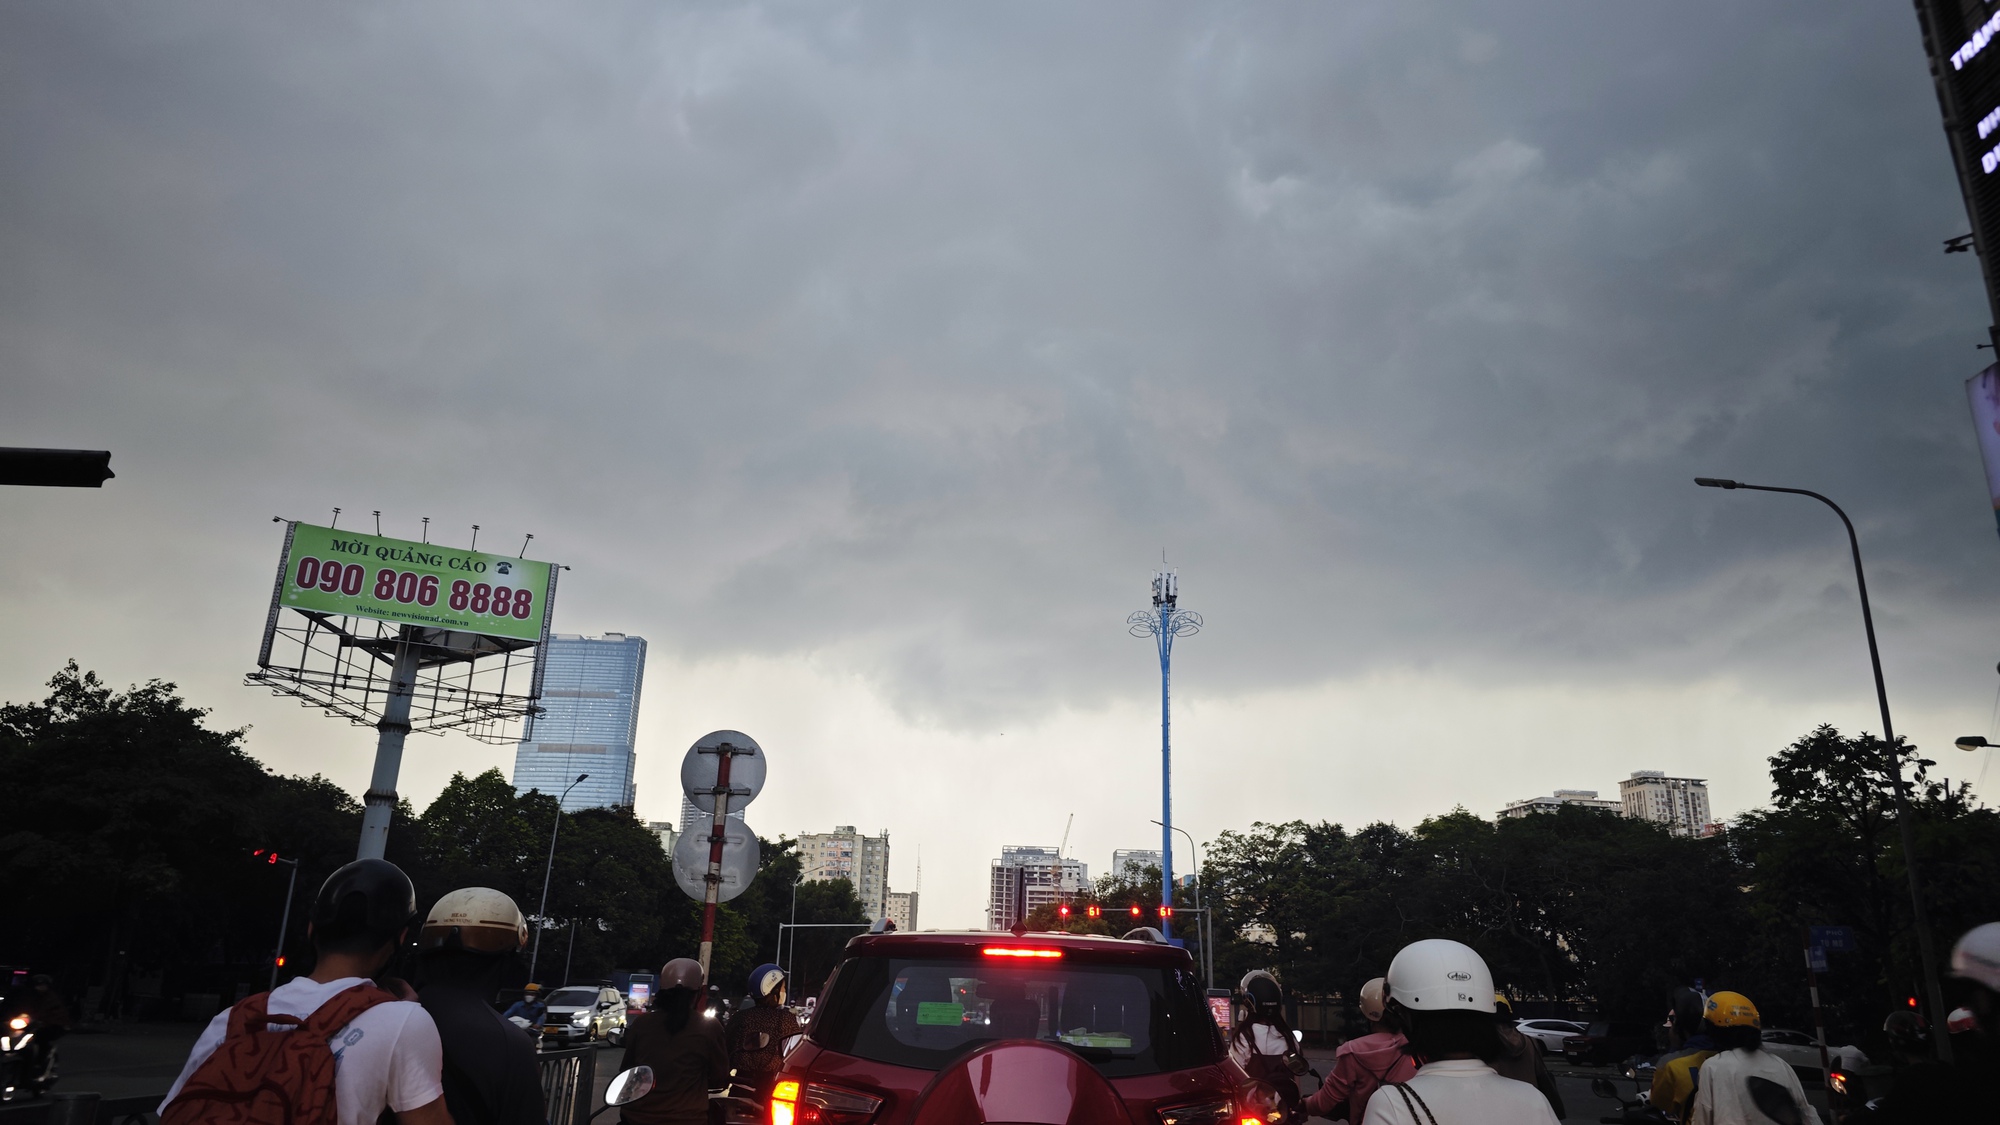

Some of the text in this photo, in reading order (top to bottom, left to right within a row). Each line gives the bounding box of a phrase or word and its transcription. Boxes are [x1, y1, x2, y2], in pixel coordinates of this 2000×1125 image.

[330, 539, 487, 574] MỜI QUẢNG CÁO
[296, 557, 533, 621] 090 806 8888
[356, 605, 469, 627] Website: newvisionad.com.vn
[1089, 907, 1099, 916] 61
[1160, 907, 1171, 916] 61
